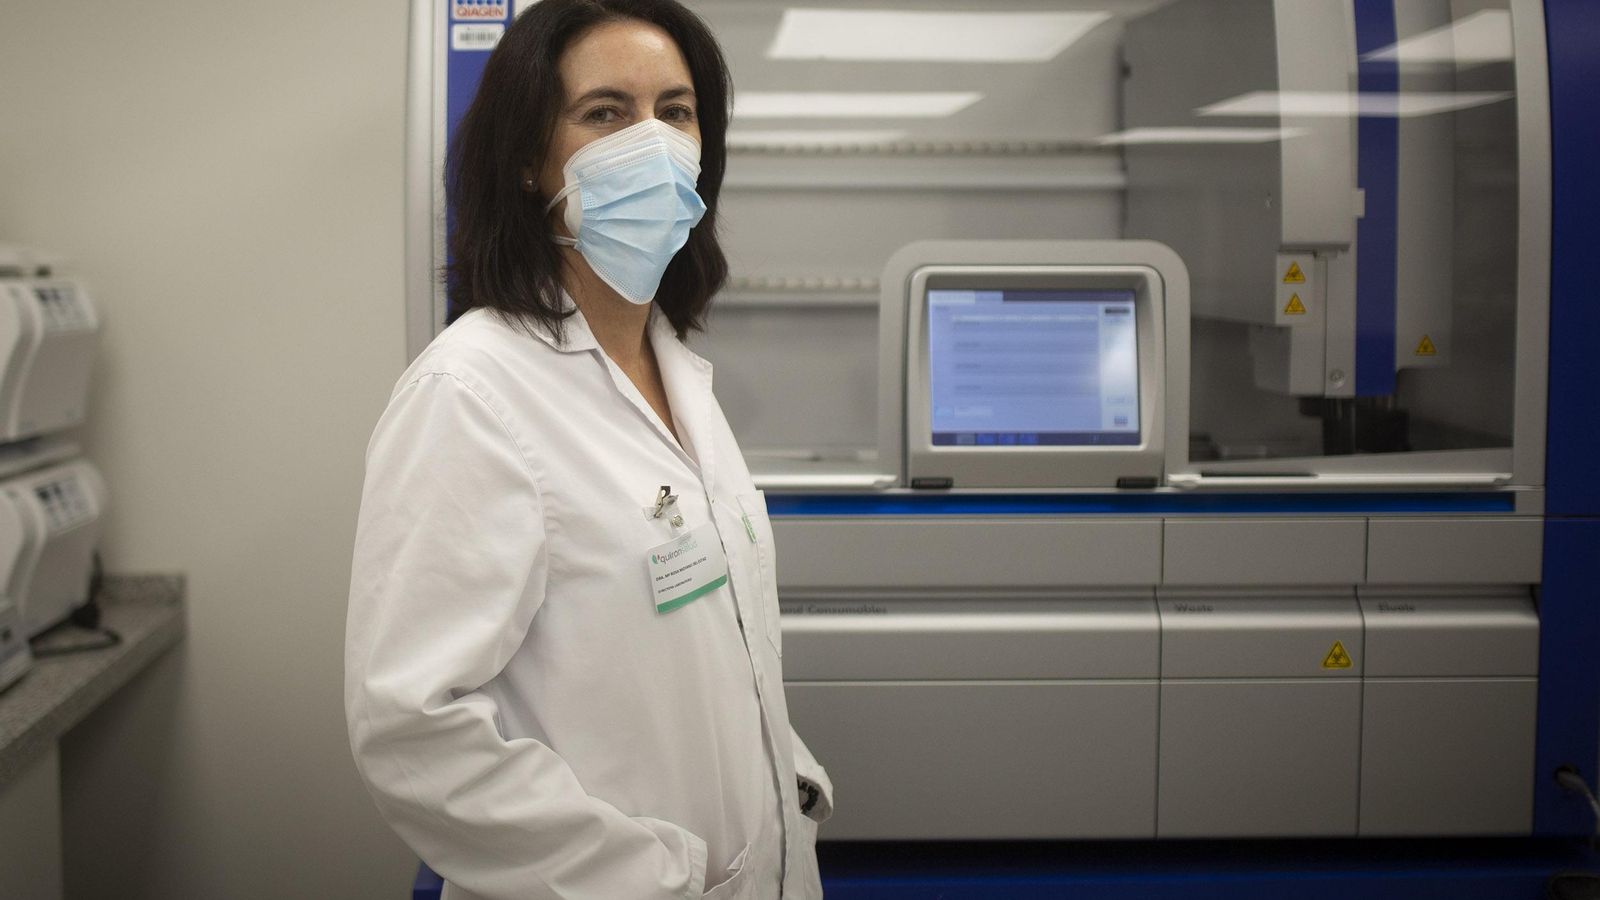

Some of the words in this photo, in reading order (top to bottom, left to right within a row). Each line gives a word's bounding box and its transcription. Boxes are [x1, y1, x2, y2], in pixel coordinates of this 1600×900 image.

[456, 6, 503, 17] QIAGEN
[807, 603, 888, 615] Consumables
[1174, 602, 1214, 613] Waste
